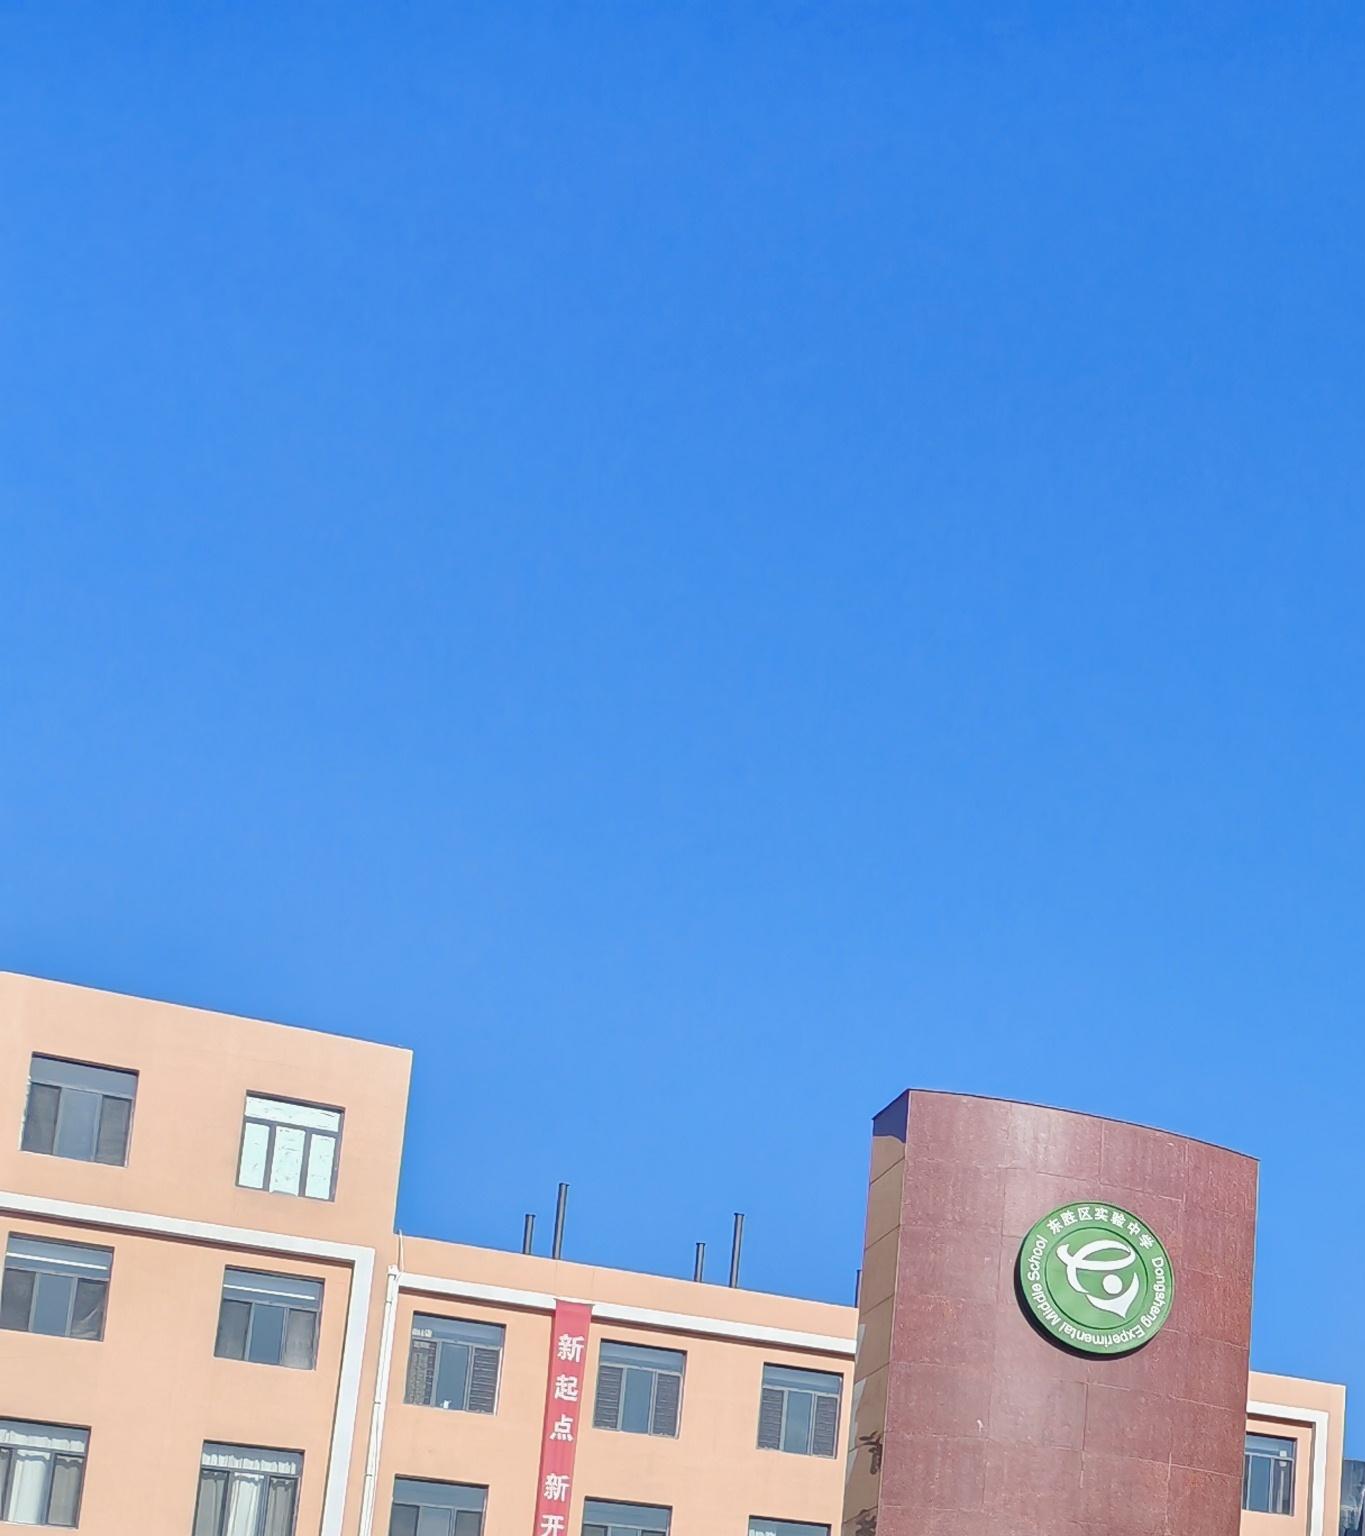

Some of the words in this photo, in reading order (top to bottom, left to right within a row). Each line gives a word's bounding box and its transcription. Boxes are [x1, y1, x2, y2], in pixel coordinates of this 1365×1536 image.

[1046, 1206, 1155, 1250] 东胜区实验中学
[1027, 1234, 1048, 1282] School
[1031, 1283, 1062, 1327] Middle
[1140, 1256, 1167, 1328] Dongsheng
[1058, 1321, 1146, 1348] Experimental
[550, 1333, 584, 1441] 新起点
